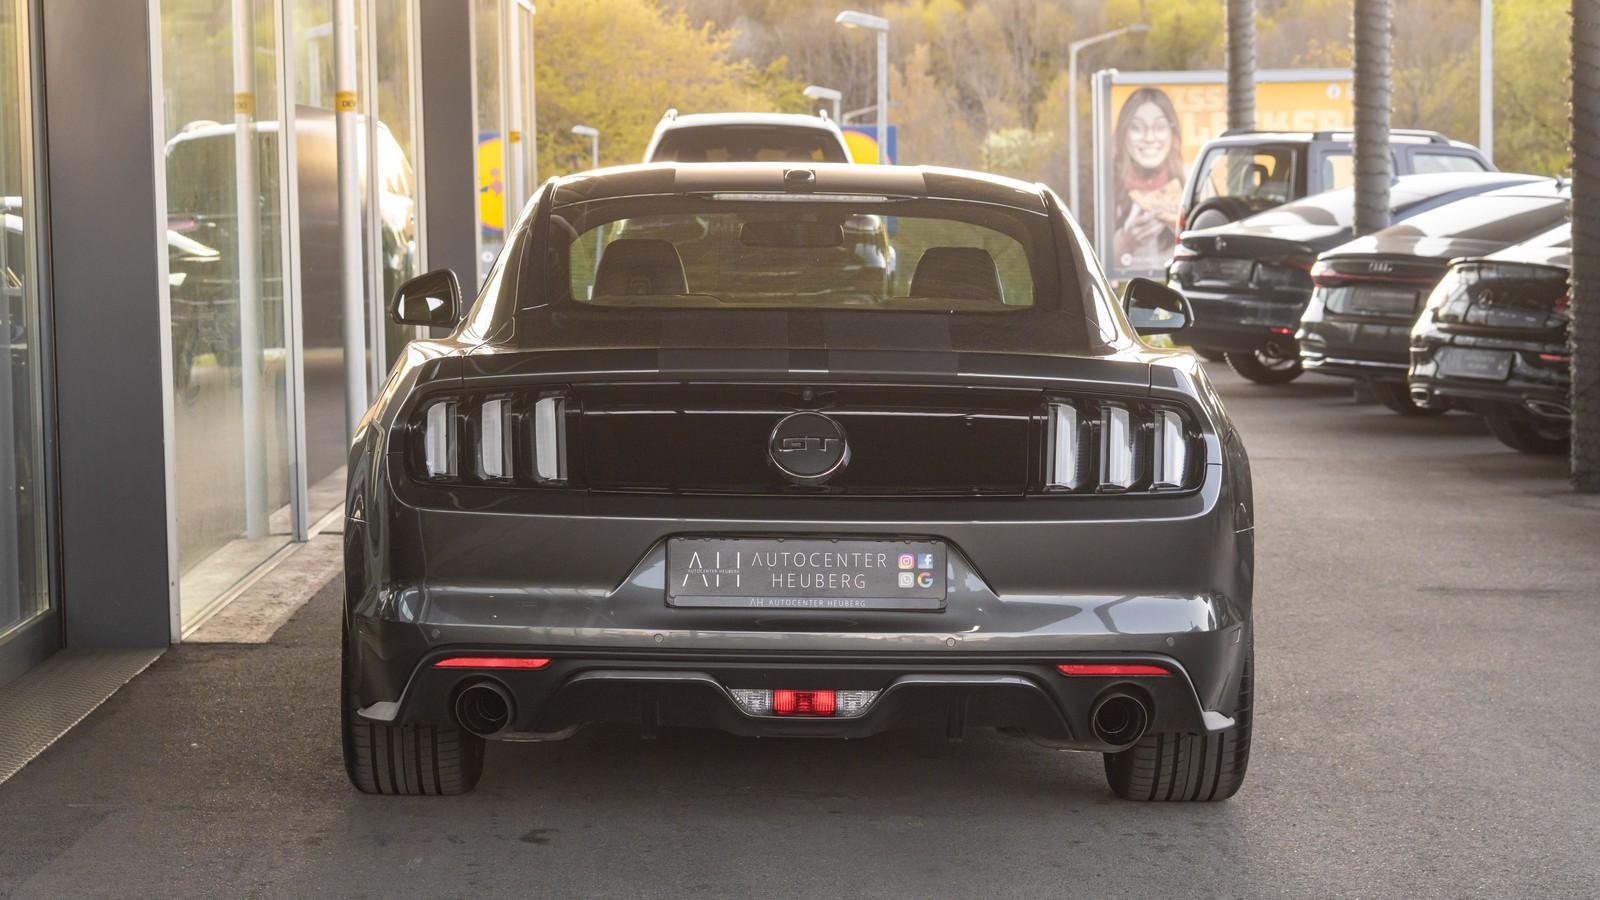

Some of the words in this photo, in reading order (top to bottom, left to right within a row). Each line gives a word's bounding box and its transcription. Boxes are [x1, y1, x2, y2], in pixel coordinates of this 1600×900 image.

[779, 437, 839, 452] GT
[751, 552, 888, 568] AUTOCENTER
[771, 572, 867, 589] HEUBERG
[768, 599, 824, 607] AUTOCENTER
[827, 599, 867, 607] HEUBERG
